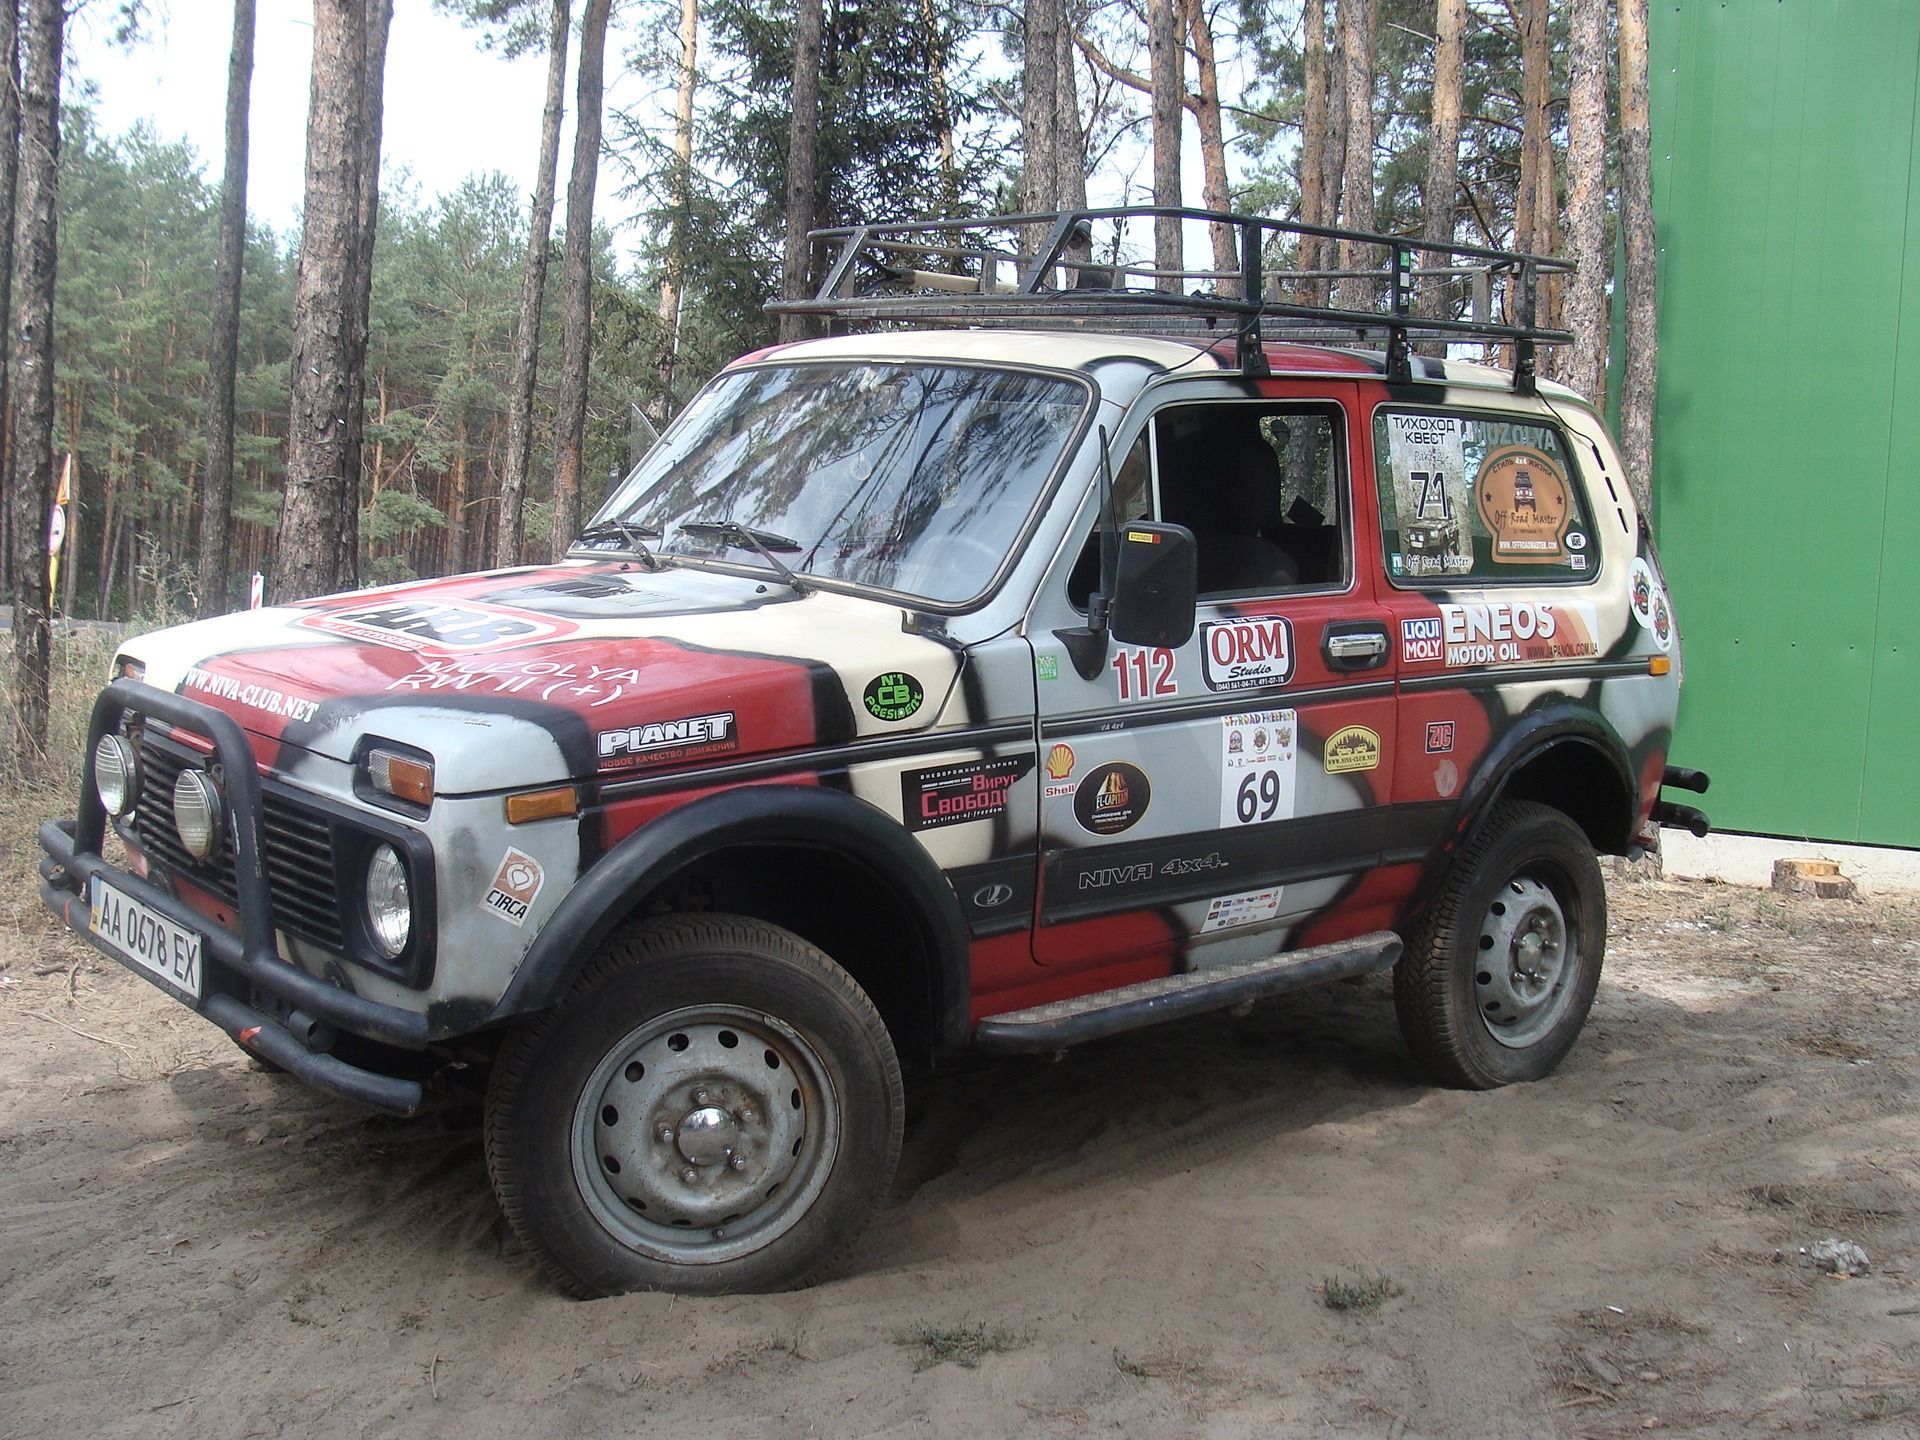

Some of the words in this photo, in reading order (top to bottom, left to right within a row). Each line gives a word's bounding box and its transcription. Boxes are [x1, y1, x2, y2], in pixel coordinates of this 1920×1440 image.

[1393, 417, 1456, 433] ТИХОХОД
[1405, 432, 1446, 444] КВЕСТ
[1492, 458, 1514, 474] СТИЛЬ
[1527, 459, 1553, 477] ЖИЗНИ
[1410, 471, 1448, 518] 71
[1495, 510, 1508, 530] Off
[1511, 512, 1530, 527] Road
[1532, 513, 1558, 524] Master
[1406, 553, 1420, 576] Off
[1422, 554, 1443, 571] Road
[1403, 622, 1440, 640] LIQUI
[1447, 602, 1556, 643] ENEOS
[1211, 622, 1285, 667] ORM
[1405, 640, 1442, 659] MOLY
[1447, 645, 1496, 666] MOTOR
[1499, 643, 1521, 661] OIL
[1526, 642, 1599, 660] WWW.JAPANOIL.COM.UA
[384, 674, 496, 691] RW
[415, 661, 641, 685] MUZOLYA
[1112, 647, 1177, 699] 112
[1228, 663, 1273, 679] Studio
[877, 684, 911, 705] CB
[1216, 681, 1230, 691] (044)
[598, 712, 734, 757] PLANET
[1428, 725, 1452, 748] ZIC
[601, 757, 634, 768] НОВОЕ
[636, 750, 683, 763] КАЧЕСТВО
[685, 742, 736, 756] ДВИЖЕНИЯ
[1045, 785, 1075, 797] Shell
[1237, 770, 1280, 823] 69
[1078, 863, 1154, 889] NIVA
[1160, 853, 1222, 875] 4x4
[101, 890, 121, 942] AA
[127, 906, 167, 967] 0678
[174, 931, 198, 989] EX
